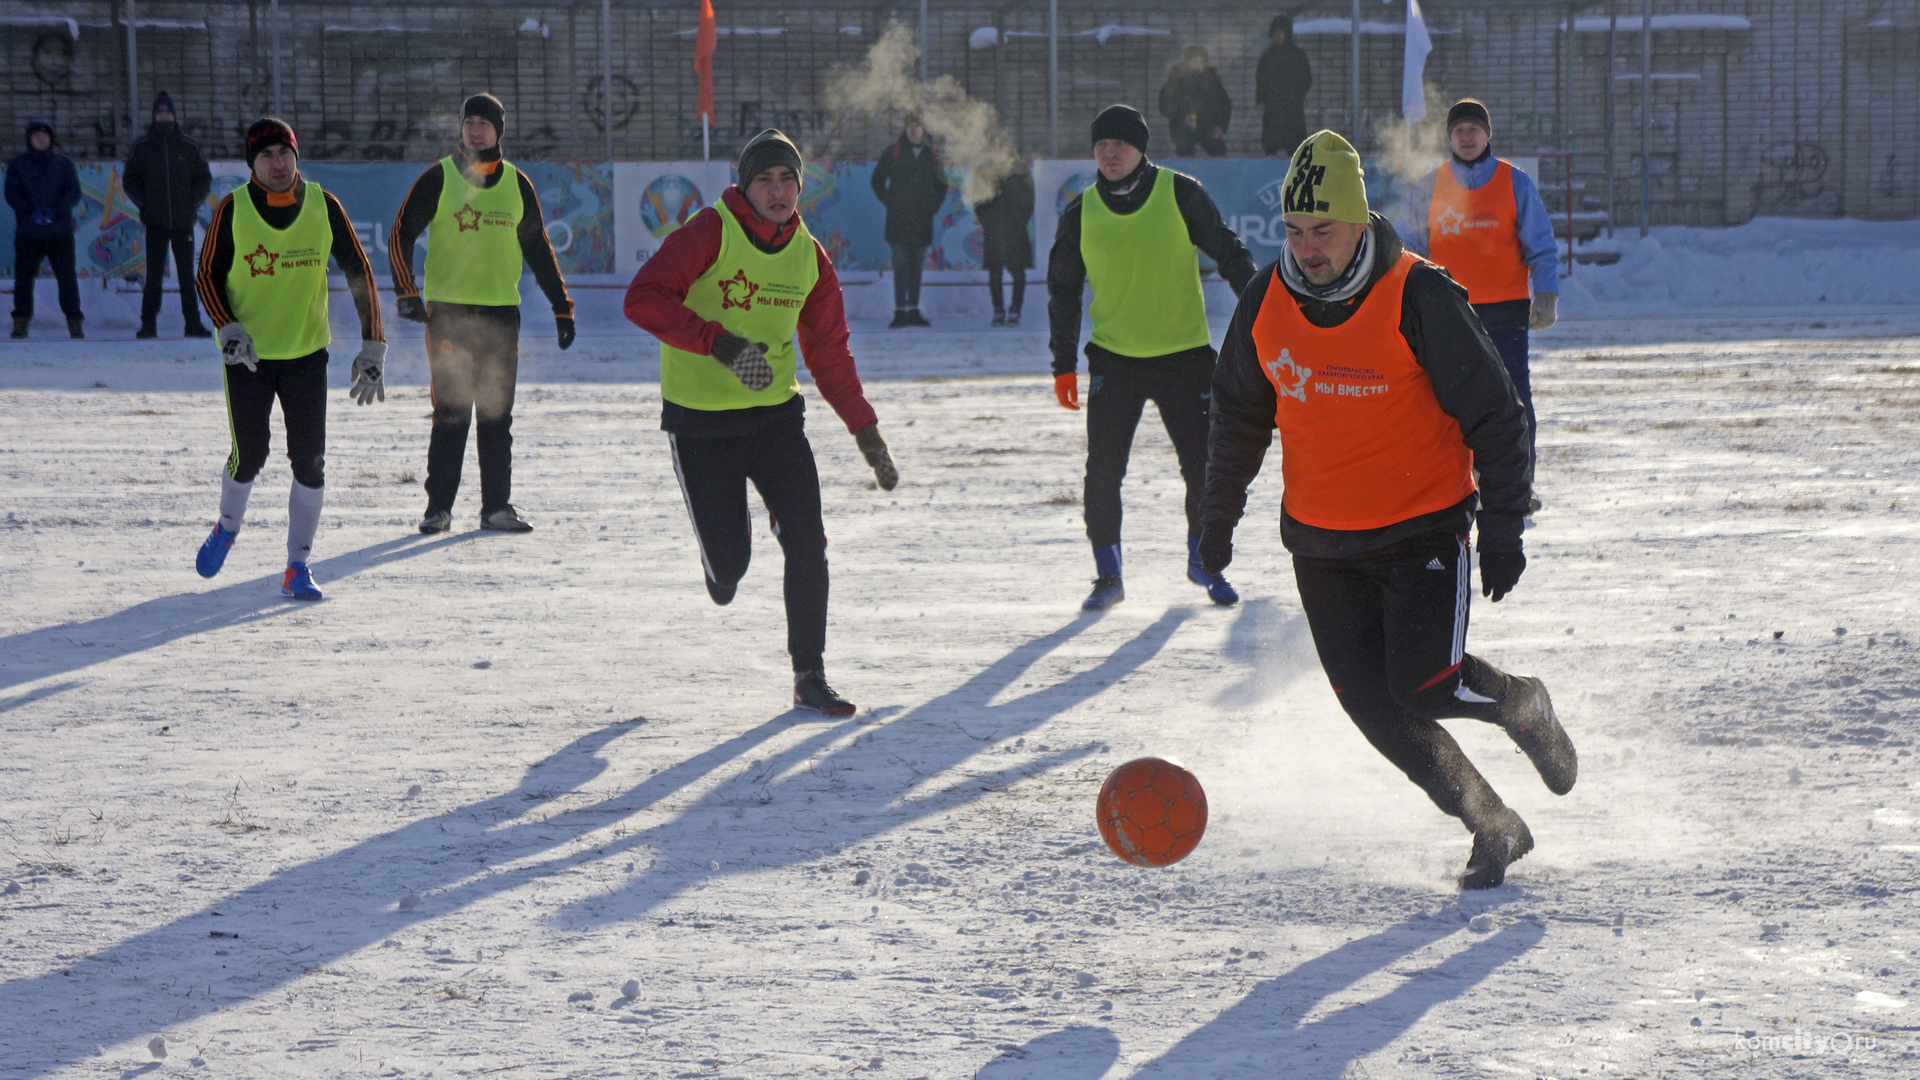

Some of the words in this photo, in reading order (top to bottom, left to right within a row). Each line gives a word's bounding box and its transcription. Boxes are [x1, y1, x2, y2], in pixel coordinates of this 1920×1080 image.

[281, 261, 294, 269] МЫ
[756, 296, 771, 306] МЫ
[773, 298, 803, 309] ВМЕСТЕ
[1326, 365, 1375, 374] ПРАВИТЕЛЬСТВО
[1318, 371, 1367, 380] ХАБАРОВСКОГО
[1314, 382, 1335, 394] МЫ
[1338, 384, 1389, 397] ВМЕСТЕ!
